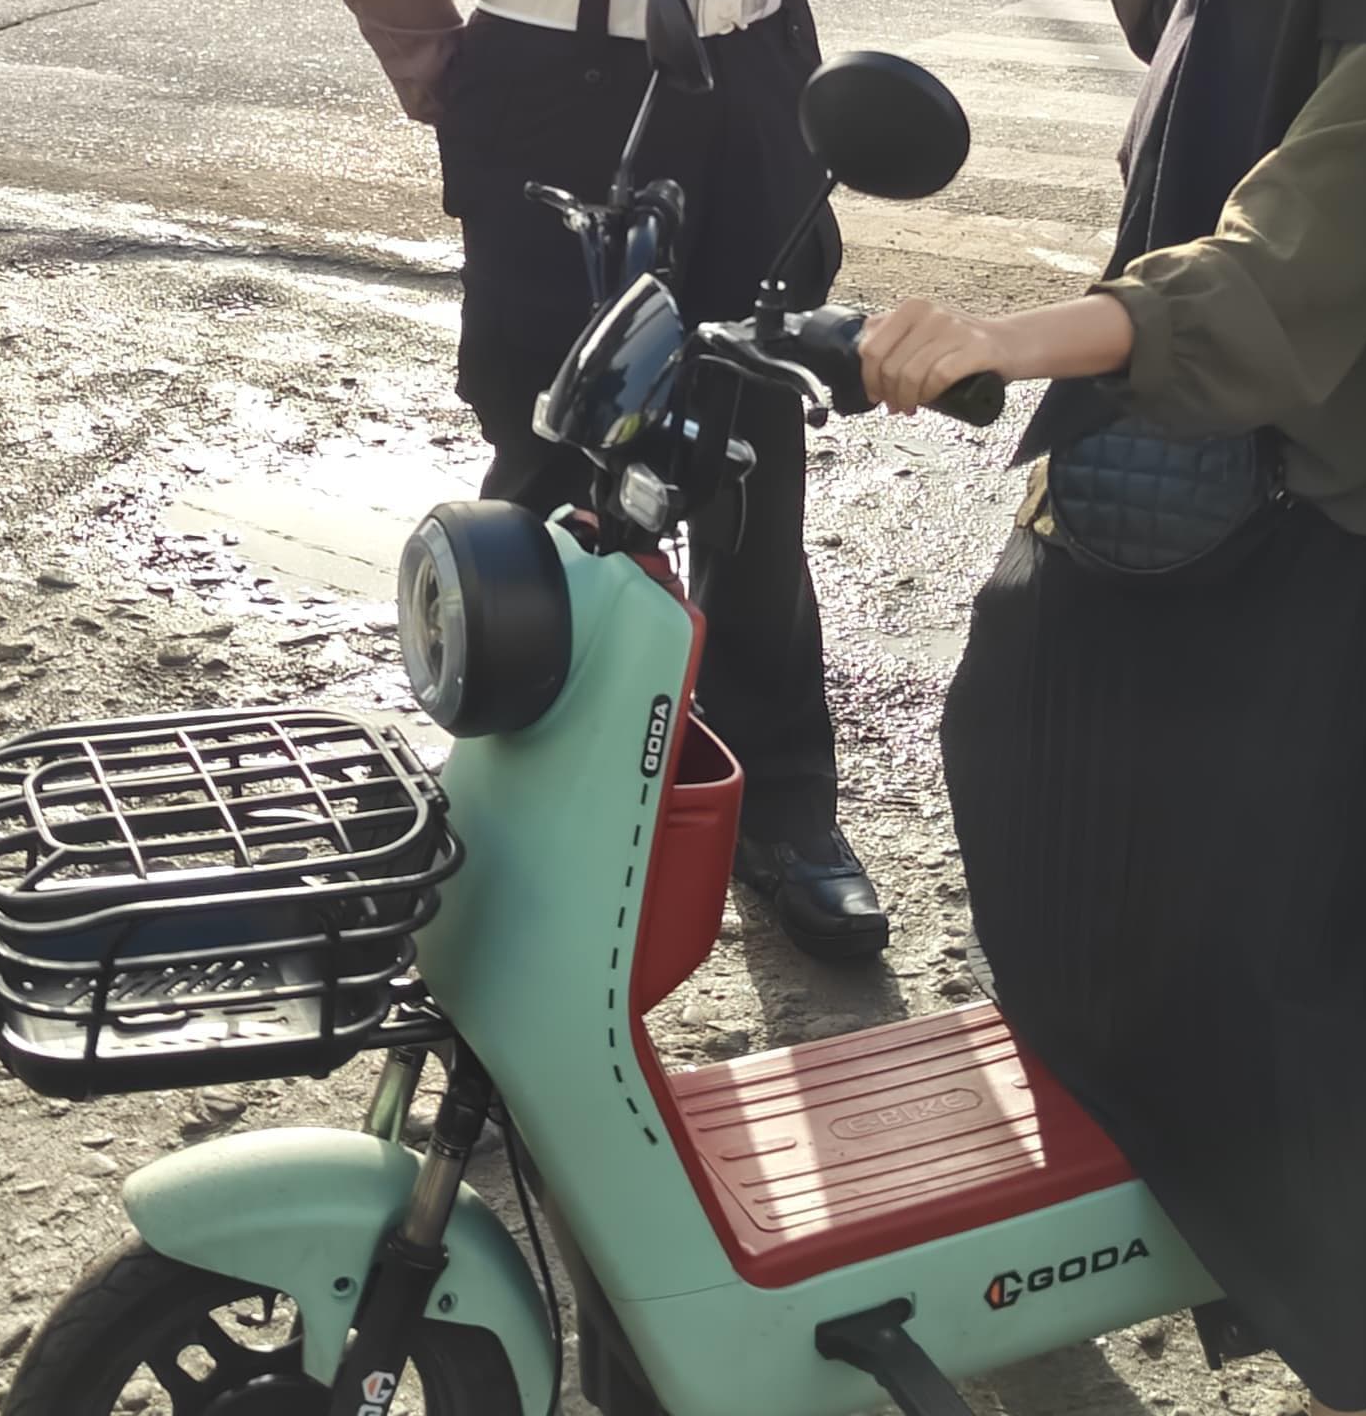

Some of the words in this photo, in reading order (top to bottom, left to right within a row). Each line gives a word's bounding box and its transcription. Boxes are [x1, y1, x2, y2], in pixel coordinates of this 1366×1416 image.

[644, 703, 669, 771] GODA
[846, 1092, 964, 1133] E-BIKE
[1026, 1237, 1150, 1293] GODA
